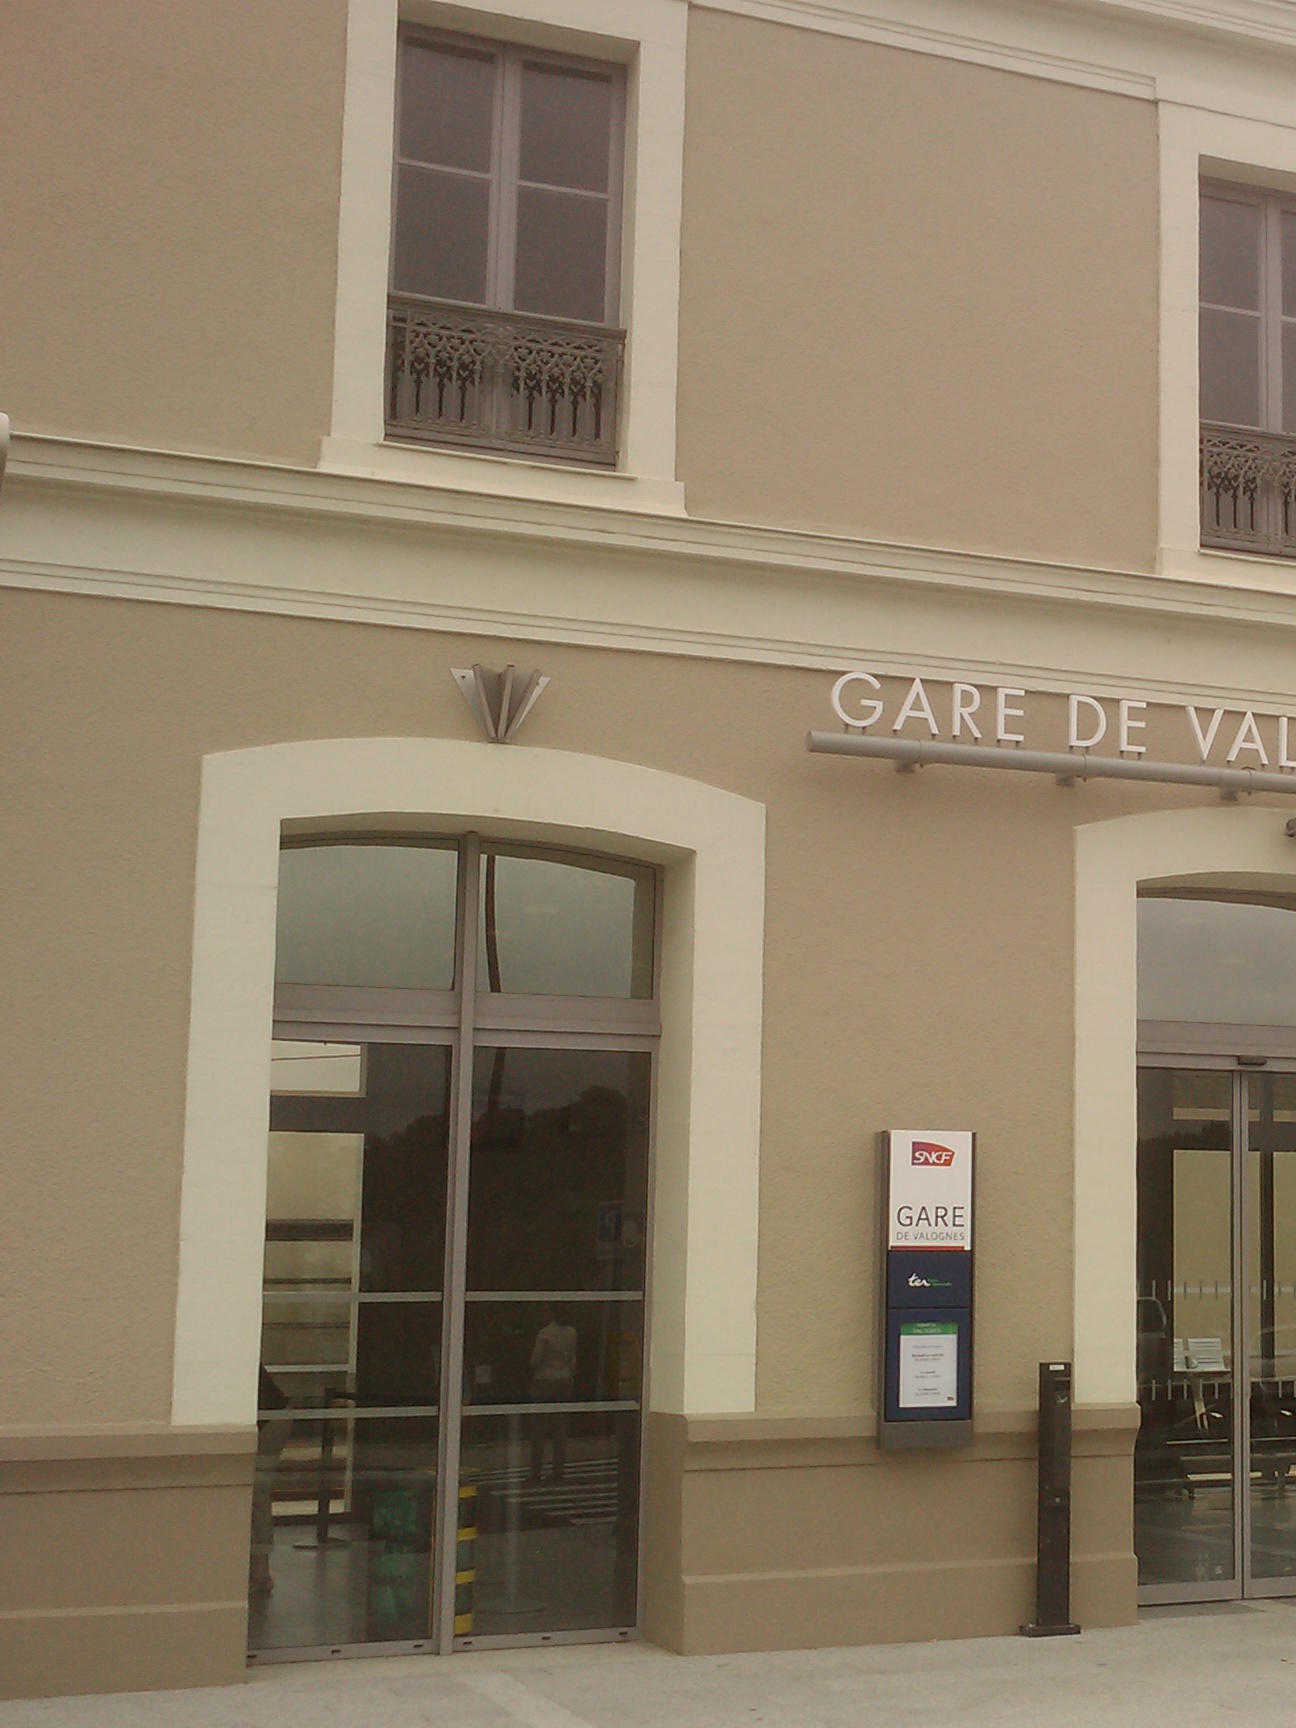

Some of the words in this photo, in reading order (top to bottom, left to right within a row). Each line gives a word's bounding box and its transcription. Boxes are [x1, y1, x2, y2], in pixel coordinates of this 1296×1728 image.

[831, 672, 1025, 742] GARE
[1068, 693, 1147, 753] DE
[913, 1151, 952, 1163] SNCF
[896, 1205, 965, 1228] GARE
[896, 1231, 910, 1241] DE
[913, 1231, 965, 1241] VALOGNES
